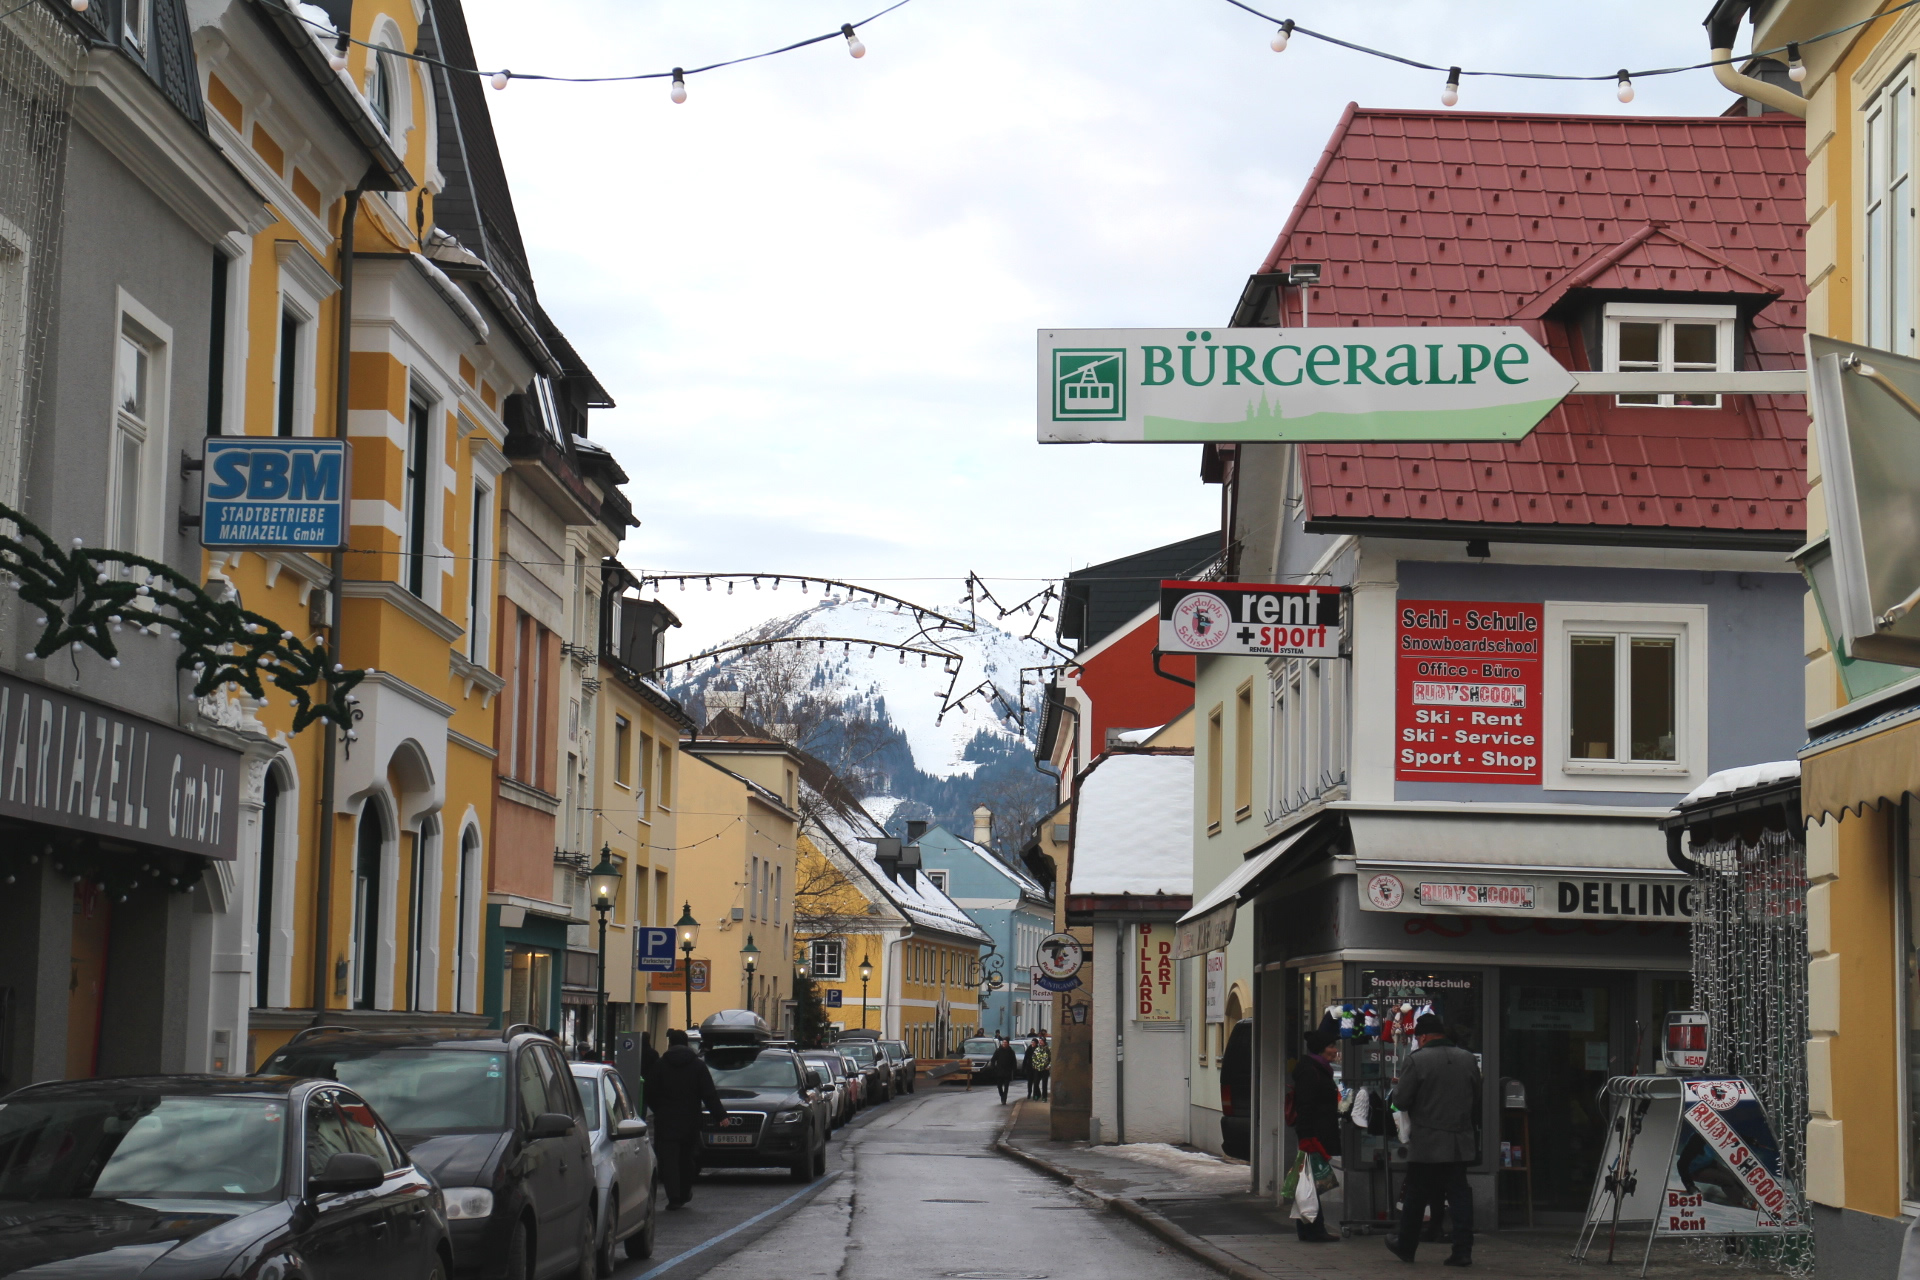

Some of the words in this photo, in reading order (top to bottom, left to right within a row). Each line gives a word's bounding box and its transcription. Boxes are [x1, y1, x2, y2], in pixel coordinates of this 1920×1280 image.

[207, 448, 341, 500] SBM
[220, 505, 326, 523] STADTBETRIEBE
[219, 523, 289, 541] MARIAZELL
[293, 526, 325, 542] GmbH
[1180, 598, 1222, 619] Rudolphs
[1241, 589, 1321, 625] rent
[1402, 608, 1448, 629] Schi
[1466, 610, 1537, 632] Schule
[1178, 625, 1225, 648] Schischule
[1259, 624, 1327, 653] sport
[1402, 634, 1537, 654] Snowboardschool
[1249, 646, 1273, 654] RENTAL
[1418, 662, 1468, 677] Office
[1482, 664, 1520, 678] Büro
[1415, 709, 1450, 724] Ski
[1471, 711, 1523, 726] Rent
[1402, 728, 1435, 743] Ski
[1454, 729, 1535, 746] Service
[1401, 748, 1462, 767] Sport
[1481, 751, 1537, 771] Shop
[168, 753, 224, 845] GmbH
[647, 930, 668, 956] P
[1139, 923, 1153, 1015] BILLARD
[1158, 941, 1172, 995] DART
[1371, 977, 1471, 989] Snowboardschule
[1684, 1055, 1705, 1066] HEAD
[1668, 1192, 1703, 1207] Best
[1680, 1208, 1694, 1218] for
[1669, 1216, 1706, 1231] Rent
